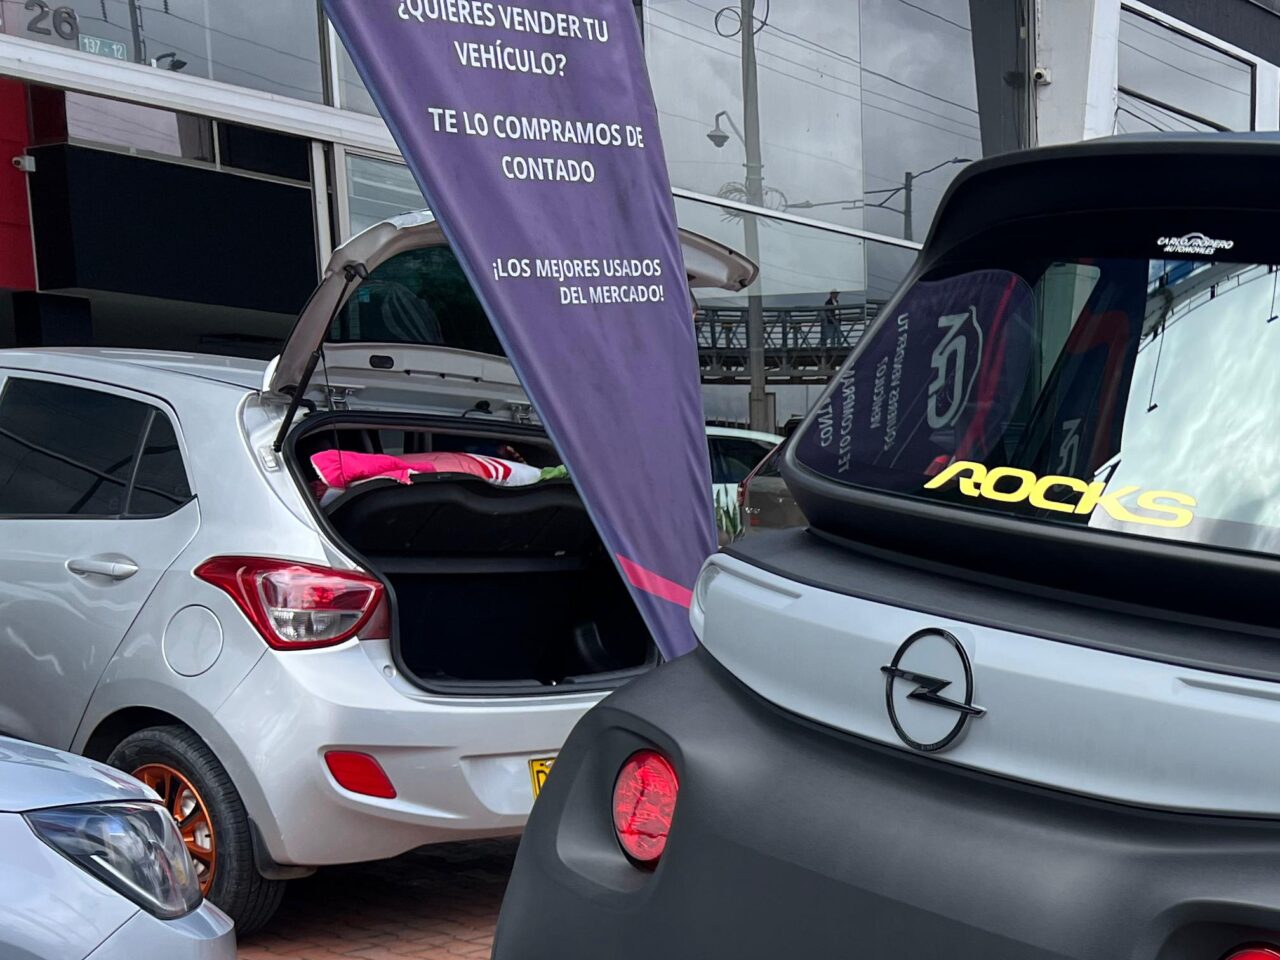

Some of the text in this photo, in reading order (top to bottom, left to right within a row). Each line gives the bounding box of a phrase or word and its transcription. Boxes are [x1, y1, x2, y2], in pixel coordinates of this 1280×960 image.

[25, 0, 80, 40] 26
[498, 4, 583, 39] VENDER
[582, 17, 609, 43] TU
[83, 38, 101, 54] 137
[111, 43, 124, 59] 12
[453, 39, 567, 77] VEHÍCULO?
[428, 107, 645, 148] TE LO COMPRAMOS DE
[501, 155, 595, 183] CONTADO
[492, 258, 662, 282] ¡LOS MEJORES USADOS
[559, 284, 665, 304] DEL MERCADO!
[923, 460, 1198, 528] ROCKS
